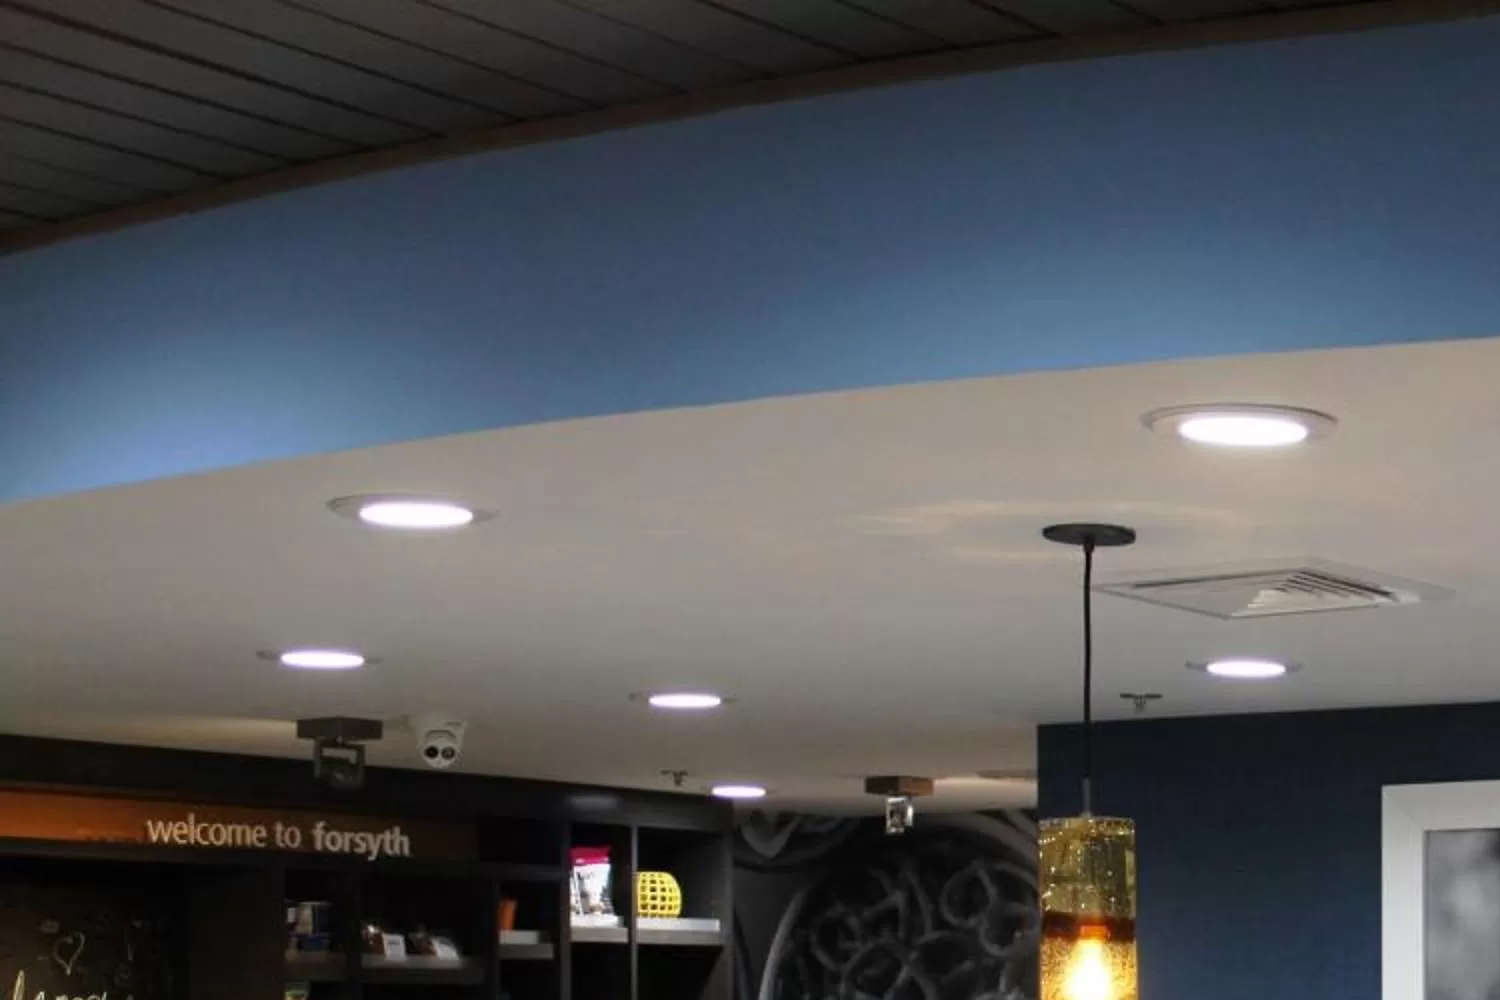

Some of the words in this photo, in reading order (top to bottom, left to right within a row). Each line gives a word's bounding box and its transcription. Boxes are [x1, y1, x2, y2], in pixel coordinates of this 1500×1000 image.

[147, 813, 267, 848] welcome
[273, 821, 300, 848] to
[312, 820, 410, 861] forsyth
